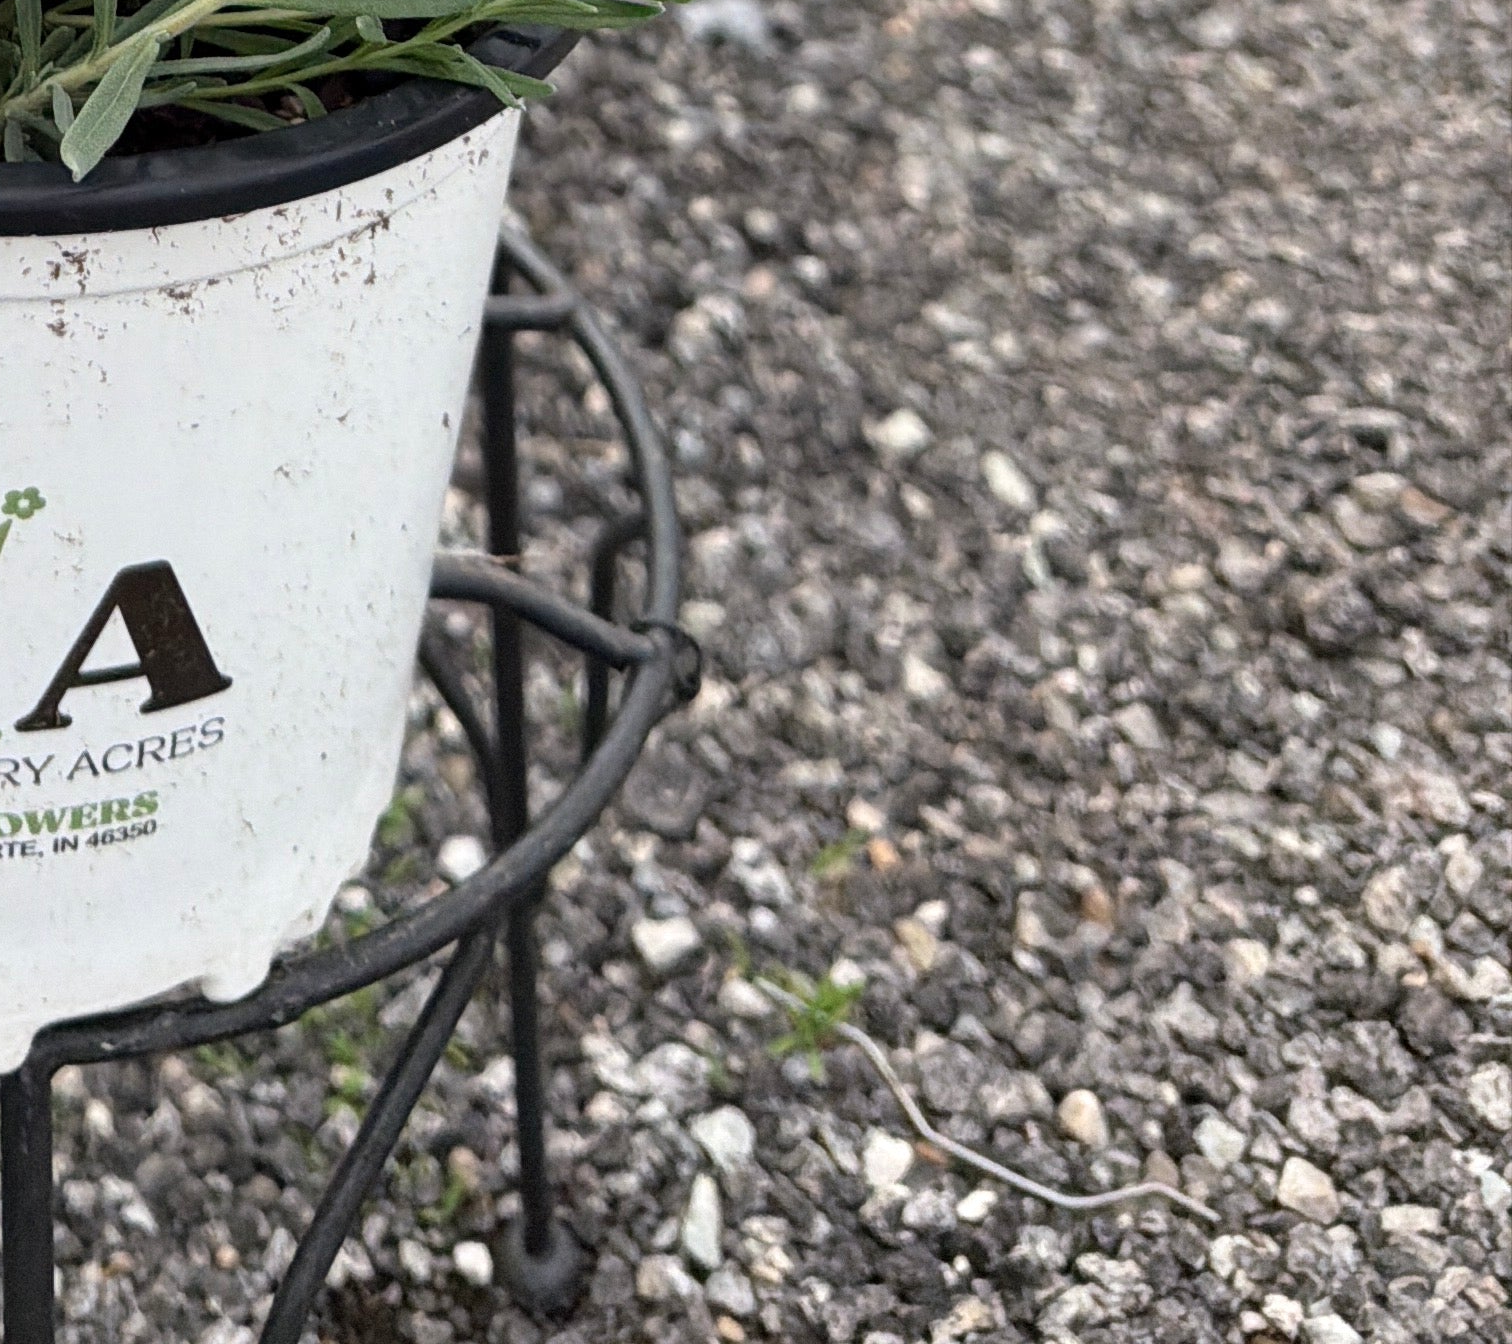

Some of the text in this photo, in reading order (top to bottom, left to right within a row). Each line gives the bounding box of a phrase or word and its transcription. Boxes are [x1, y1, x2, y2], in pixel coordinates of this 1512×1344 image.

[66, 716, 226, 781] ACRES
[52, 834, 79, 854] IN
[85, 818, 157, 849] 46350
